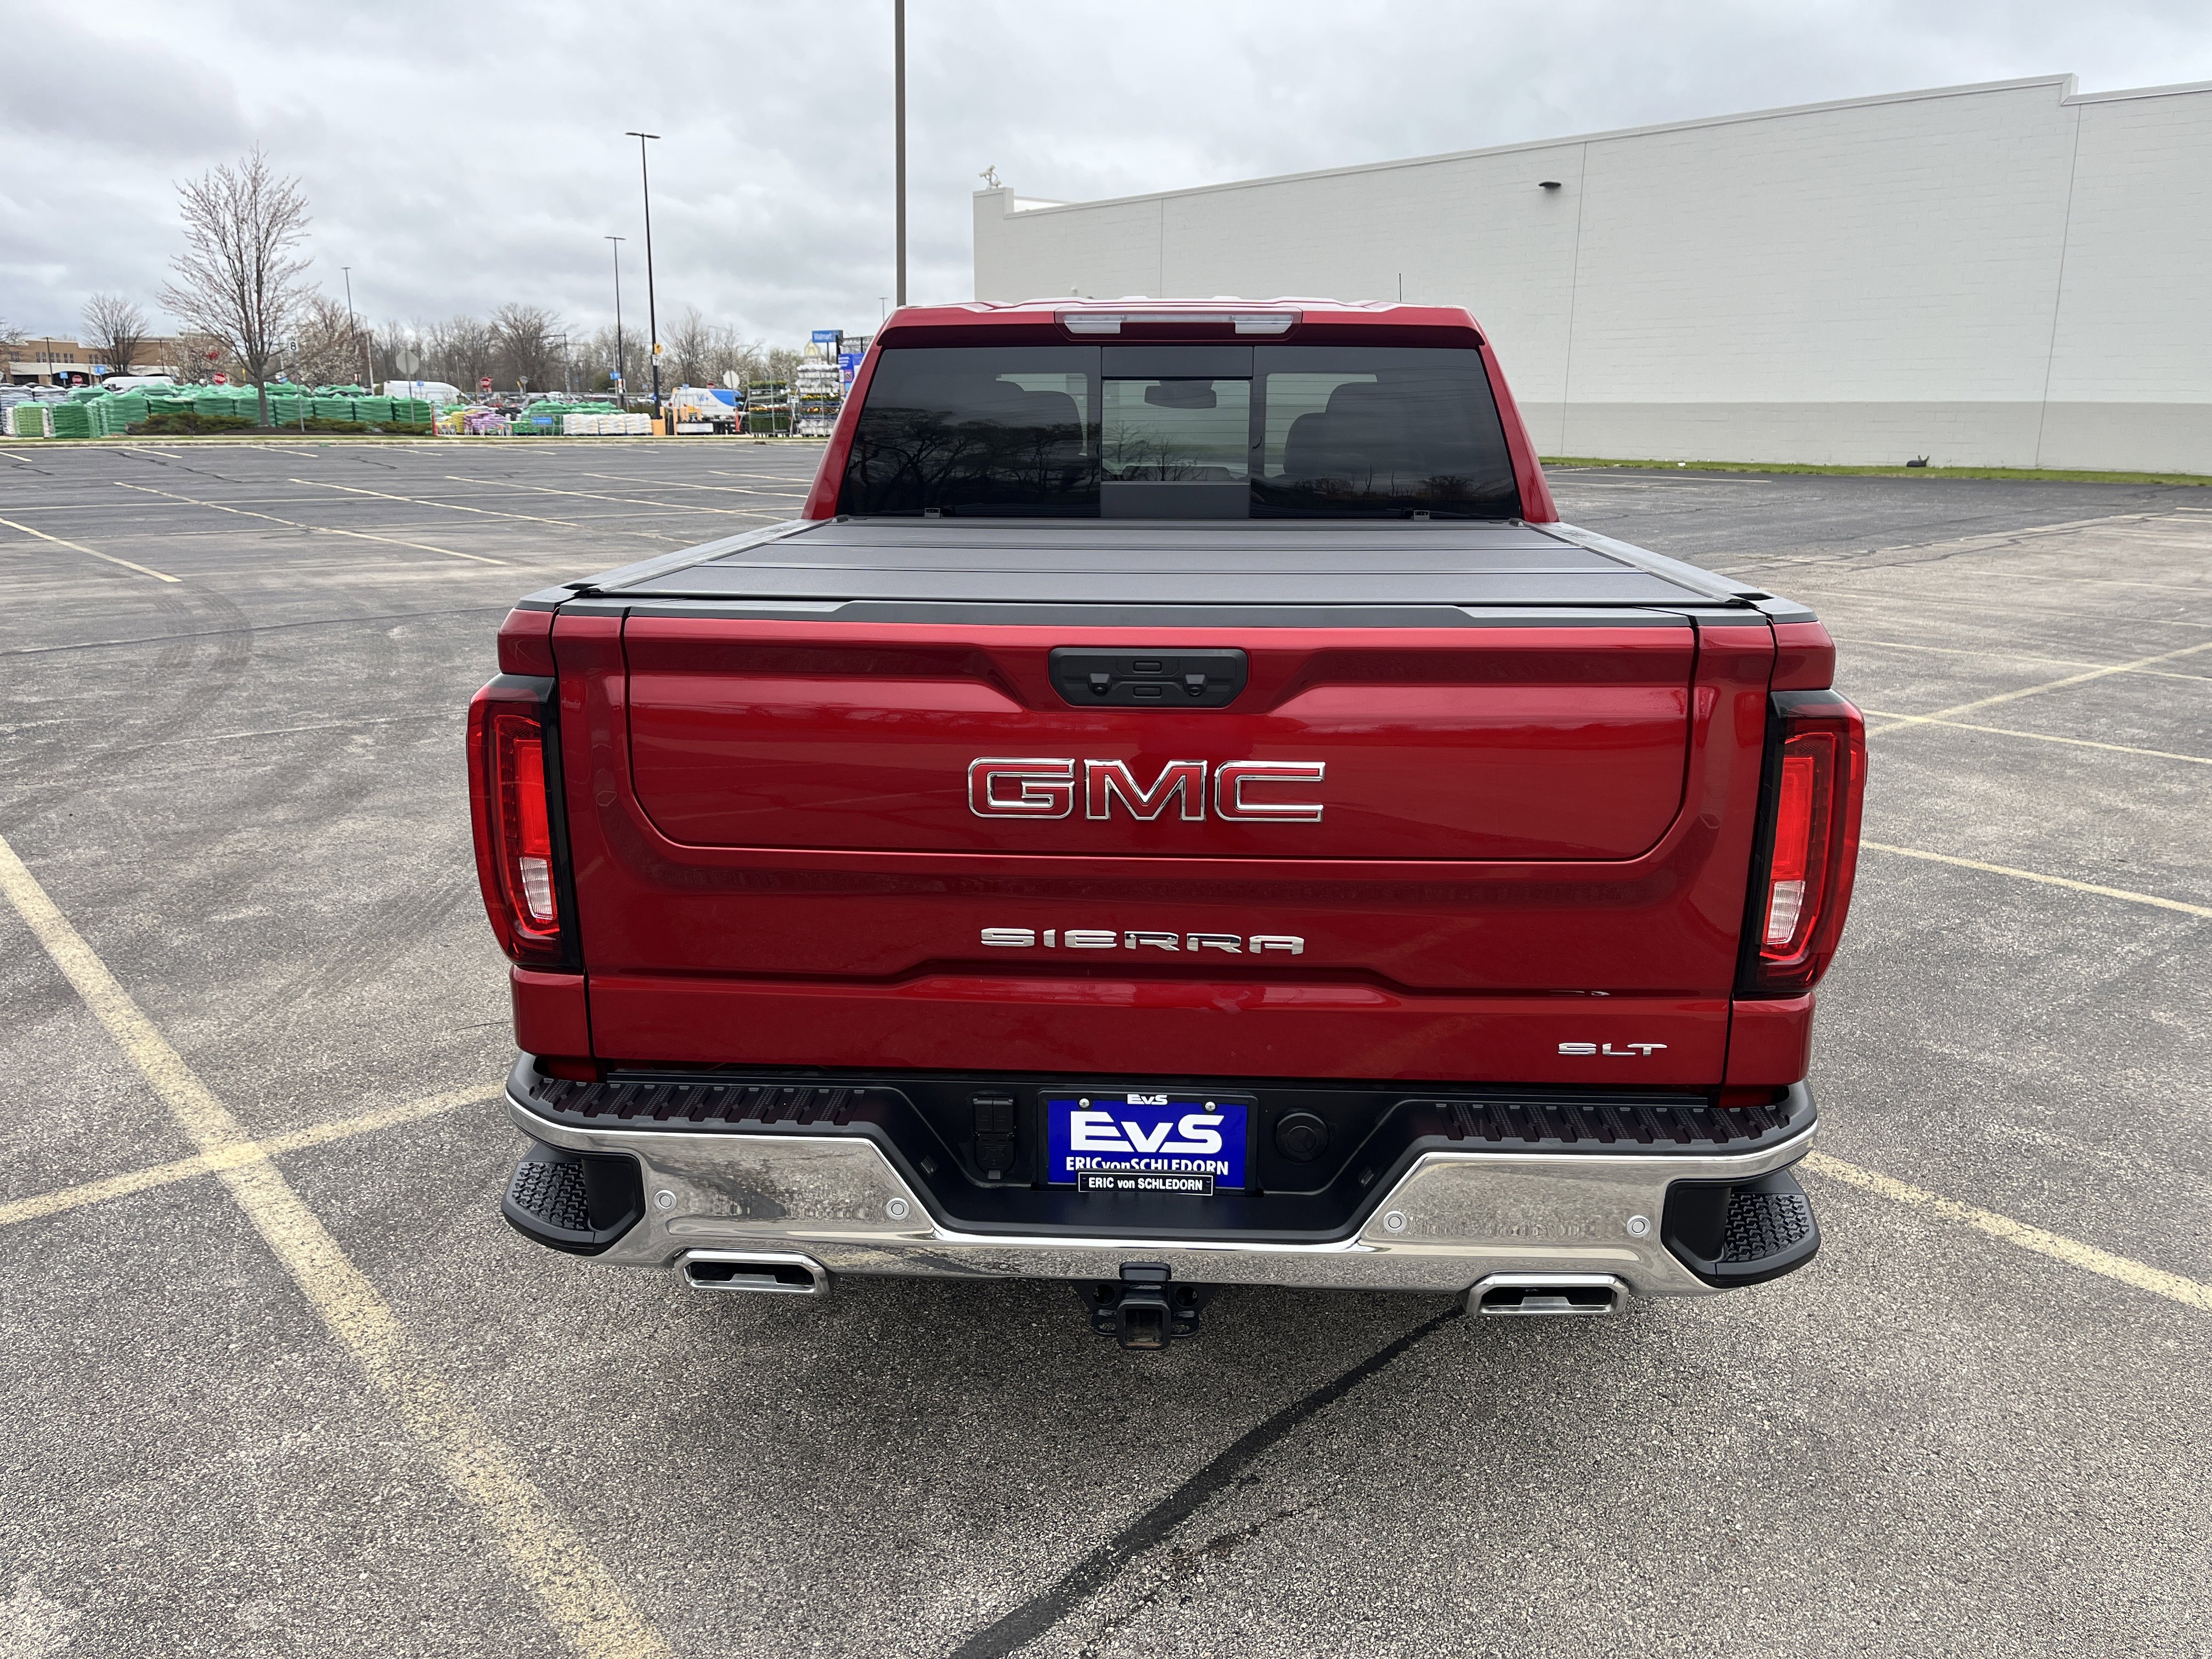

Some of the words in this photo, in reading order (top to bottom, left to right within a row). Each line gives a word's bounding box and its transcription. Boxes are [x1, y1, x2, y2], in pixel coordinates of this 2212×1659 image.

[290, 342, 296, 350] 8
[968, 757, 1325, 823] GMC
[981, 928, 1305, 955] SIERRA
[1558, 1043, 1667, 1057] SLT
[1088, 1177, 1114, 1188] ERIC
[1117, 1180, 1135, 1189] von
[1137, 1178, 1203, 1190] SCHLEDORN
